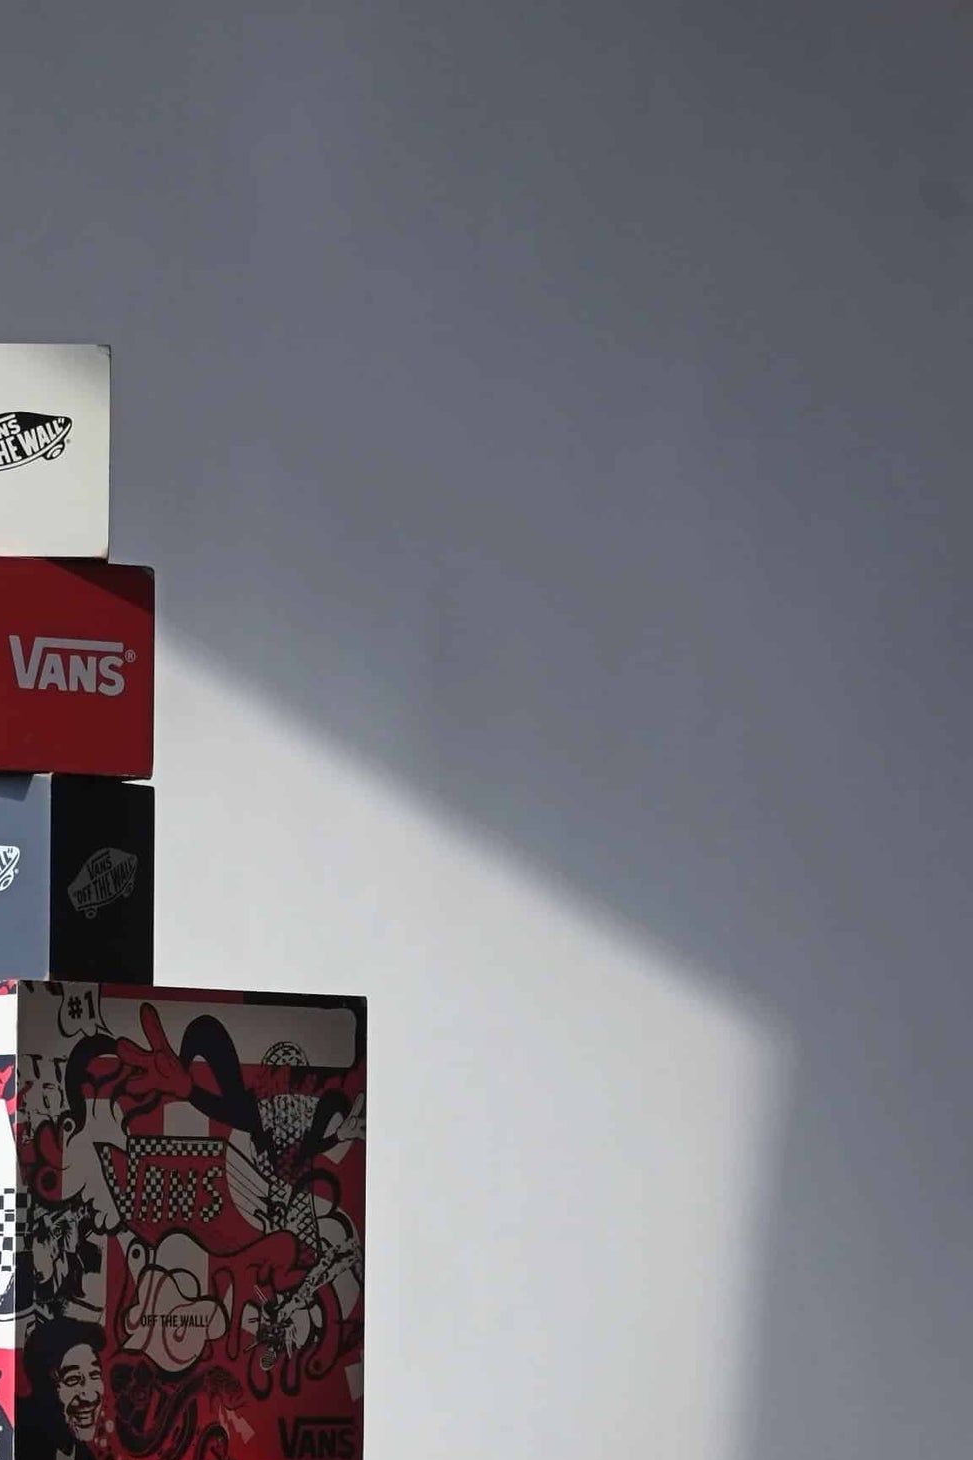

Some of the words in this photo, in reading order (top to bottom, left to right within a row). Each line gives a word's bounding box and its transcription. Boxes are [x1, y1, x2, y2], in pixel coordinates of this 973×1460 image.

[68, 989, 95, 1020] #1
[93, 1135, 226, 1223] VANS
[140, 1313, 157, 1328] OFF
[159, 1313, 178, 1328] THE
[277, 1416, 356, 1460] VANS
